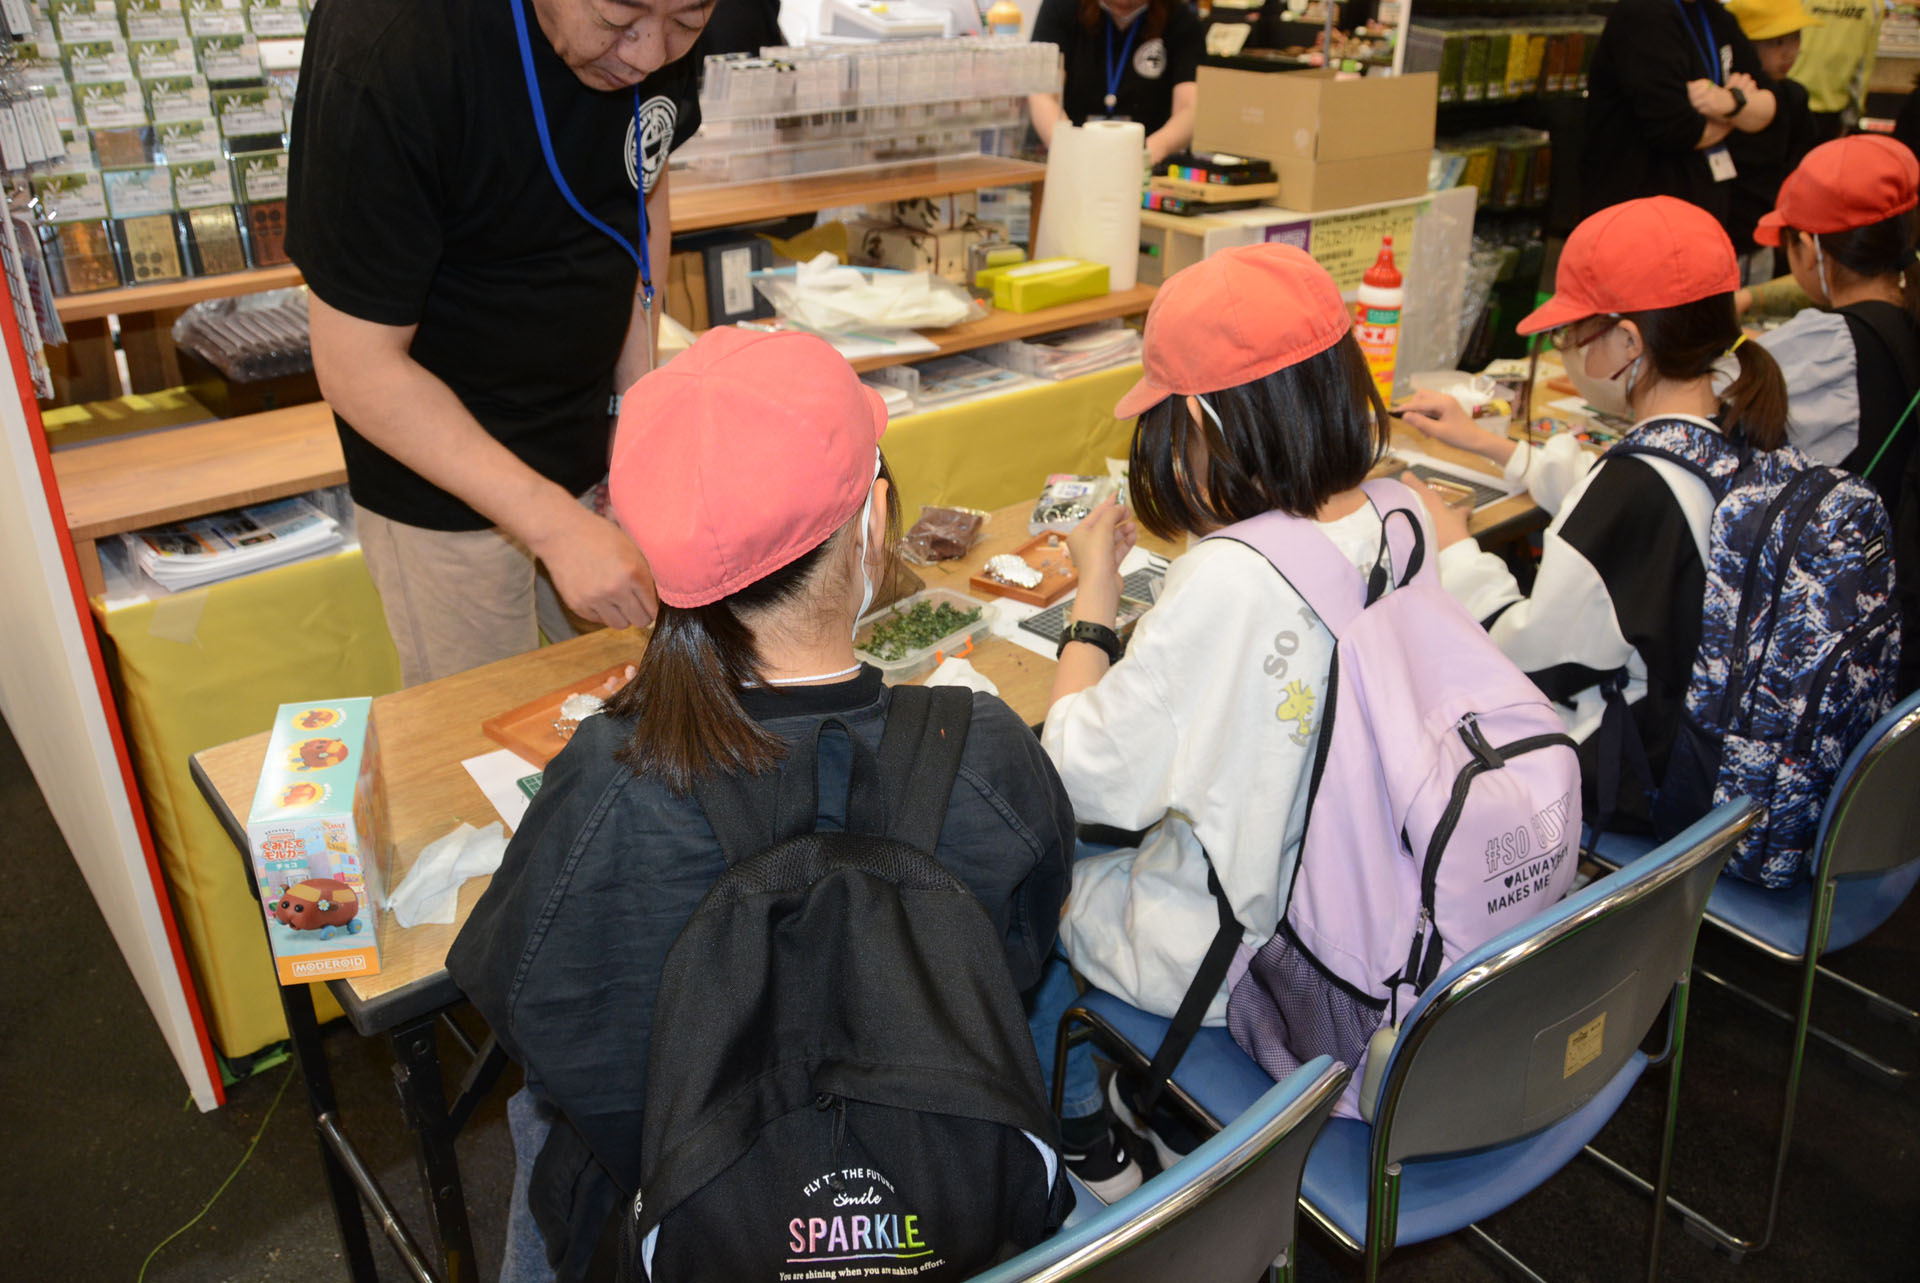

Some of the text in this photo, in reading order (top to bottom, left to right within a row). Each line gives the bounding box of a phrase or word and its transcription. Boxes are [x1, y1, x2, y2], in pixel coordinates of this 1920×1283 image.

[262, 838, 305, 850] くみたて
[263, 849, 307, 860] モルカー
[1487, 874, 1550, 915] MAKES ME
[296, 957, 363, 973] MODEROID
[803, 1178, 821, 1197] FLY
[842, 1168, 864, 1180] THE
[866, 1168, 895, 1194] FUTURE
[833, 1186, 882, 1207] Smile
[789, 1213, 926, 1253] SPARKLE
[779, 1271, 792, 1281] You
[805, 1268, 837, 1280] shining
[838, 1267, 862, 1277] when
[864, 1267, 880, 1276] you
[881, 1267, 892, 1275] are
[920, 1259, 946, 1272] effort.
